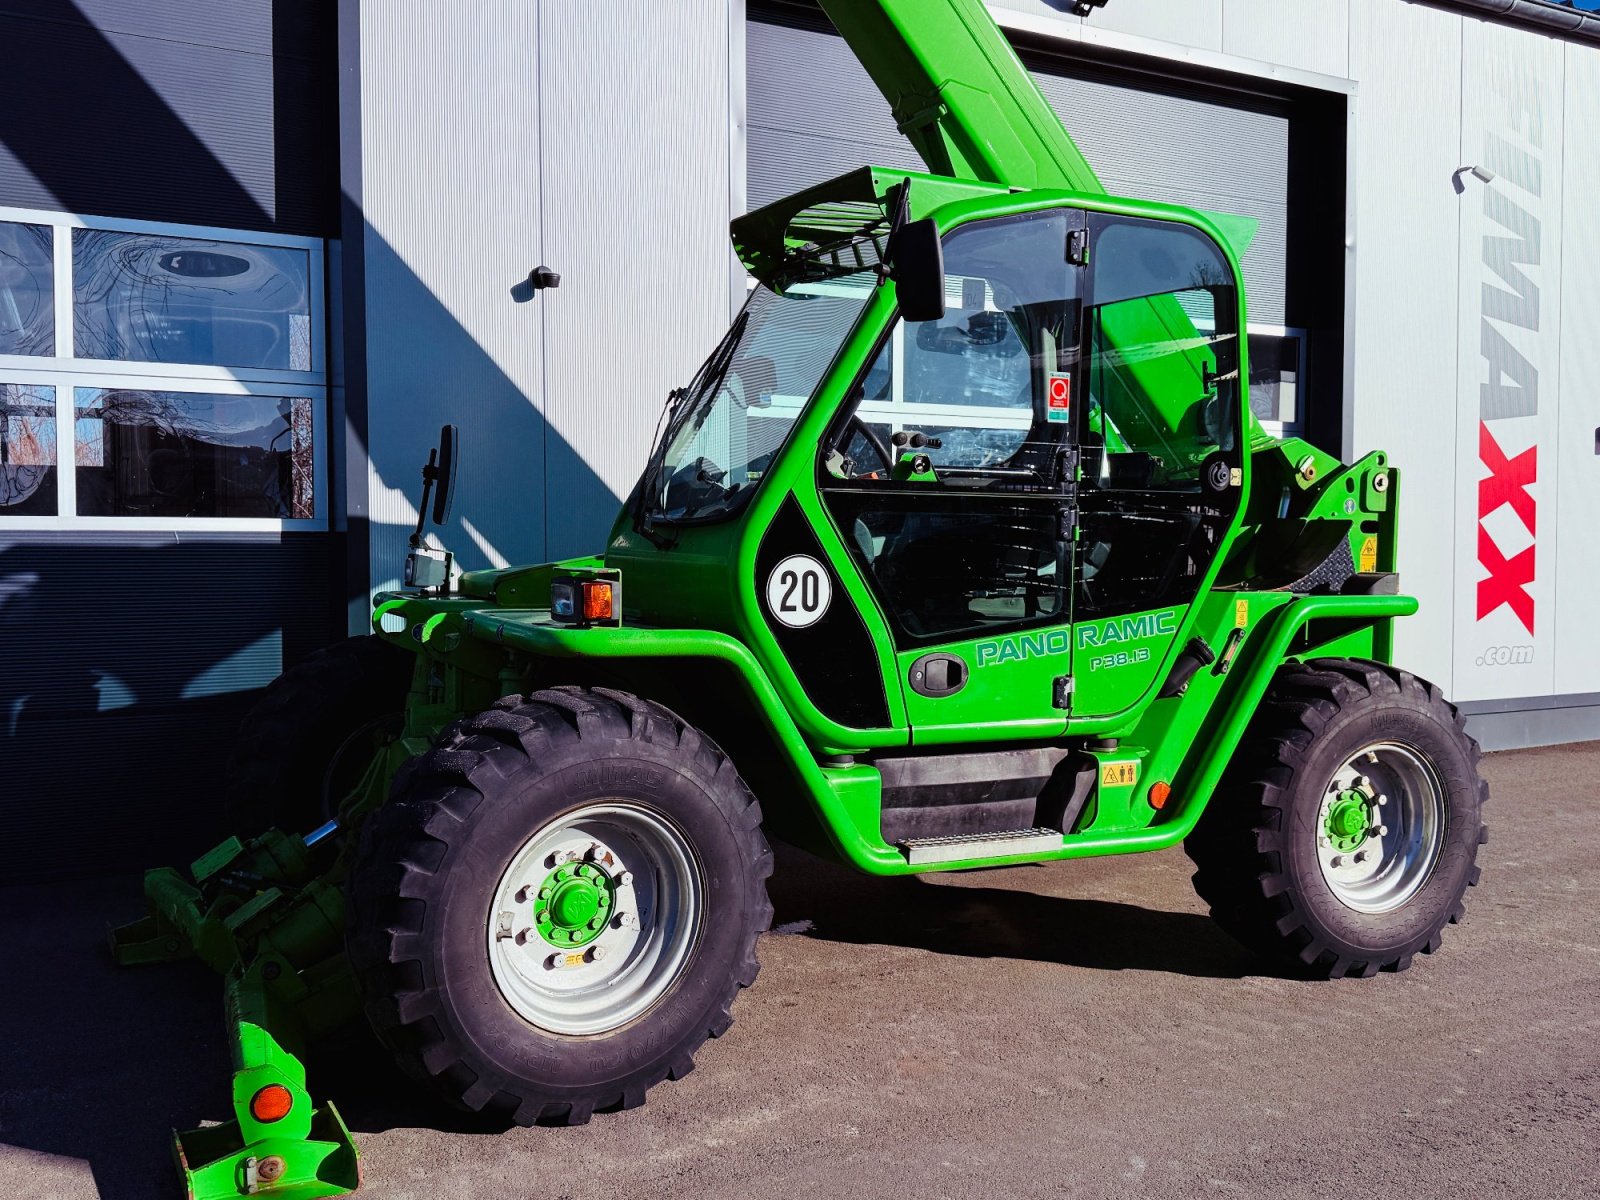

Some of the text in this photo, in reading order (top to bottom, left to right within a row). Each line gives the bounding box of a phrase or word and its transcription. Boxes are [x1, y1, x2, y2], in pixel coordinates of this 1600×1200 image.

[780, 570, 819, 612] 20
[1090, 648, 1150, 671] P38.13
[1475, 645, 1534, 667] .com
